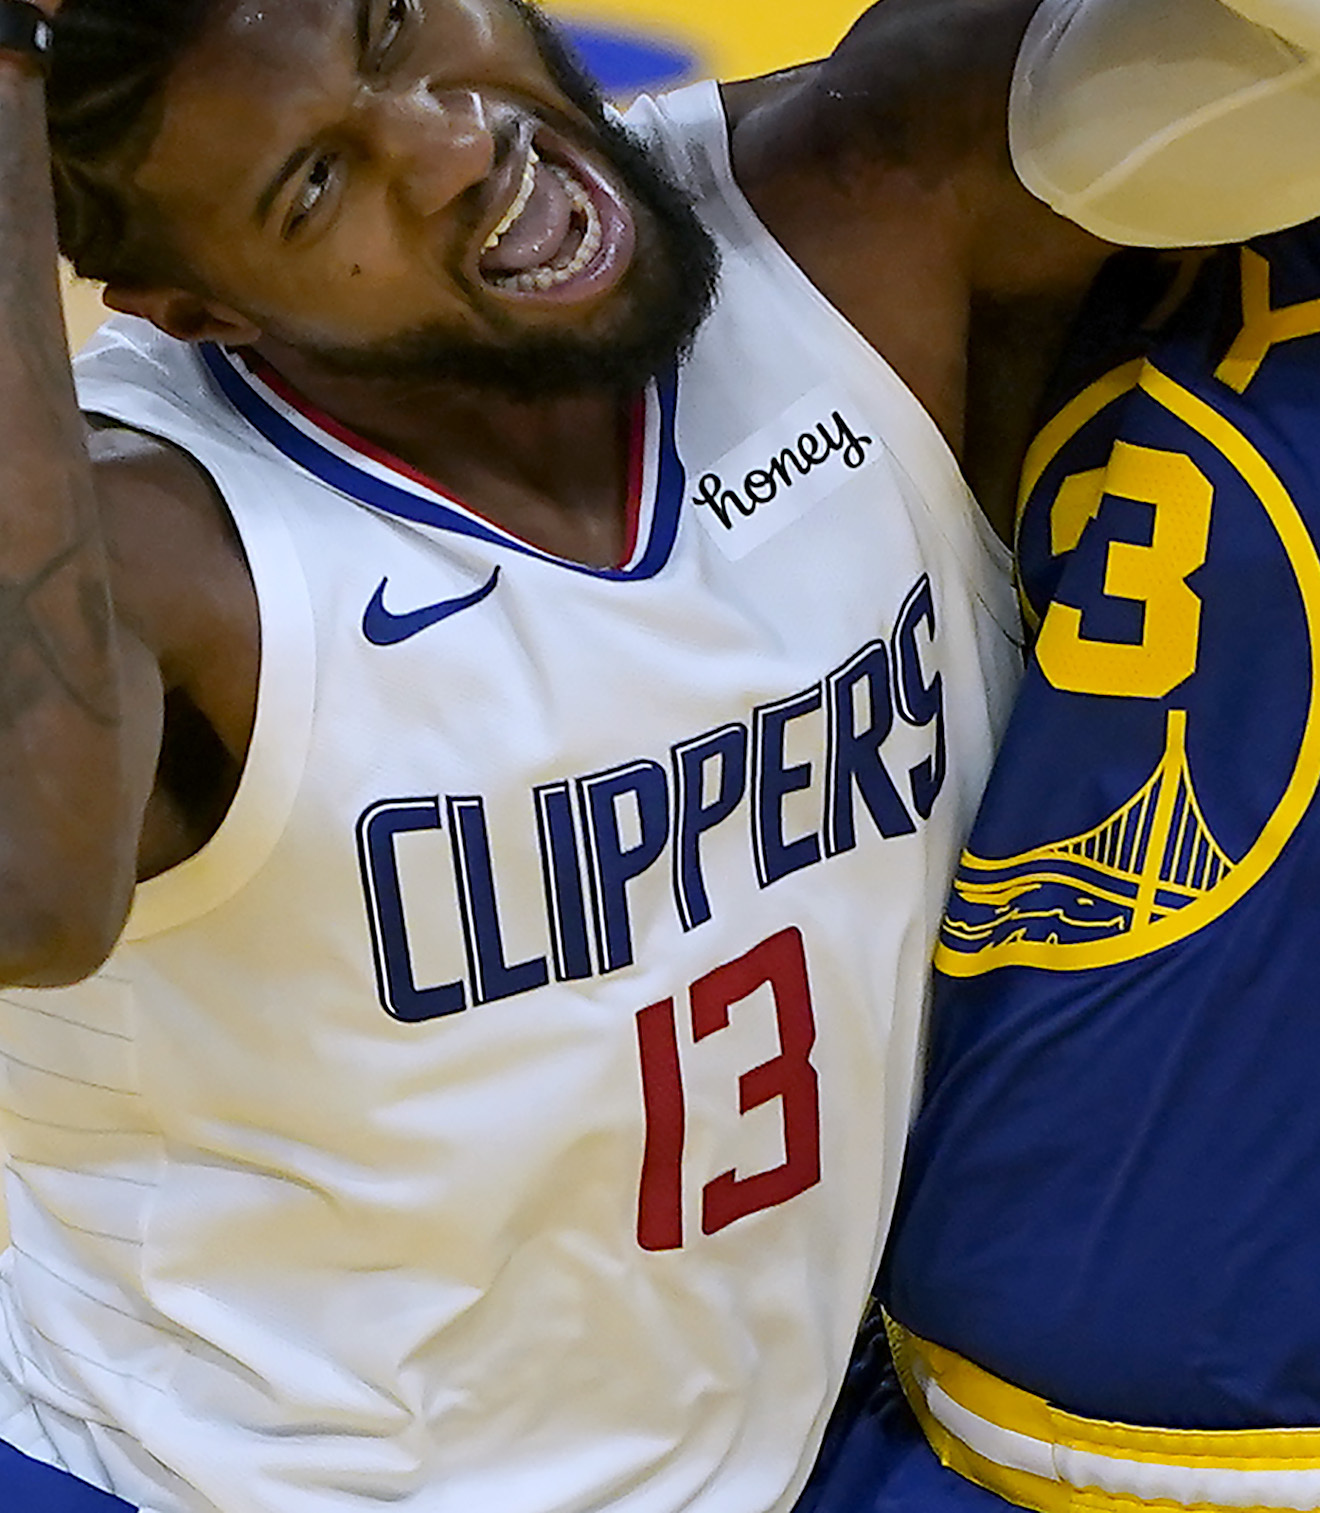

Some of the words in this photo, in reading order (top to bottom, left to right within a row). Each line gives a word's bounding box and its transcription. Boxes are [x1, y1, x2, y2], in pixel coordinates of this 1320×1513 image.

[691, 411, 872, 529] honey
[355, 573, 947, 1023] CLIPPERS
[636, 926, 821, 1251] 13
